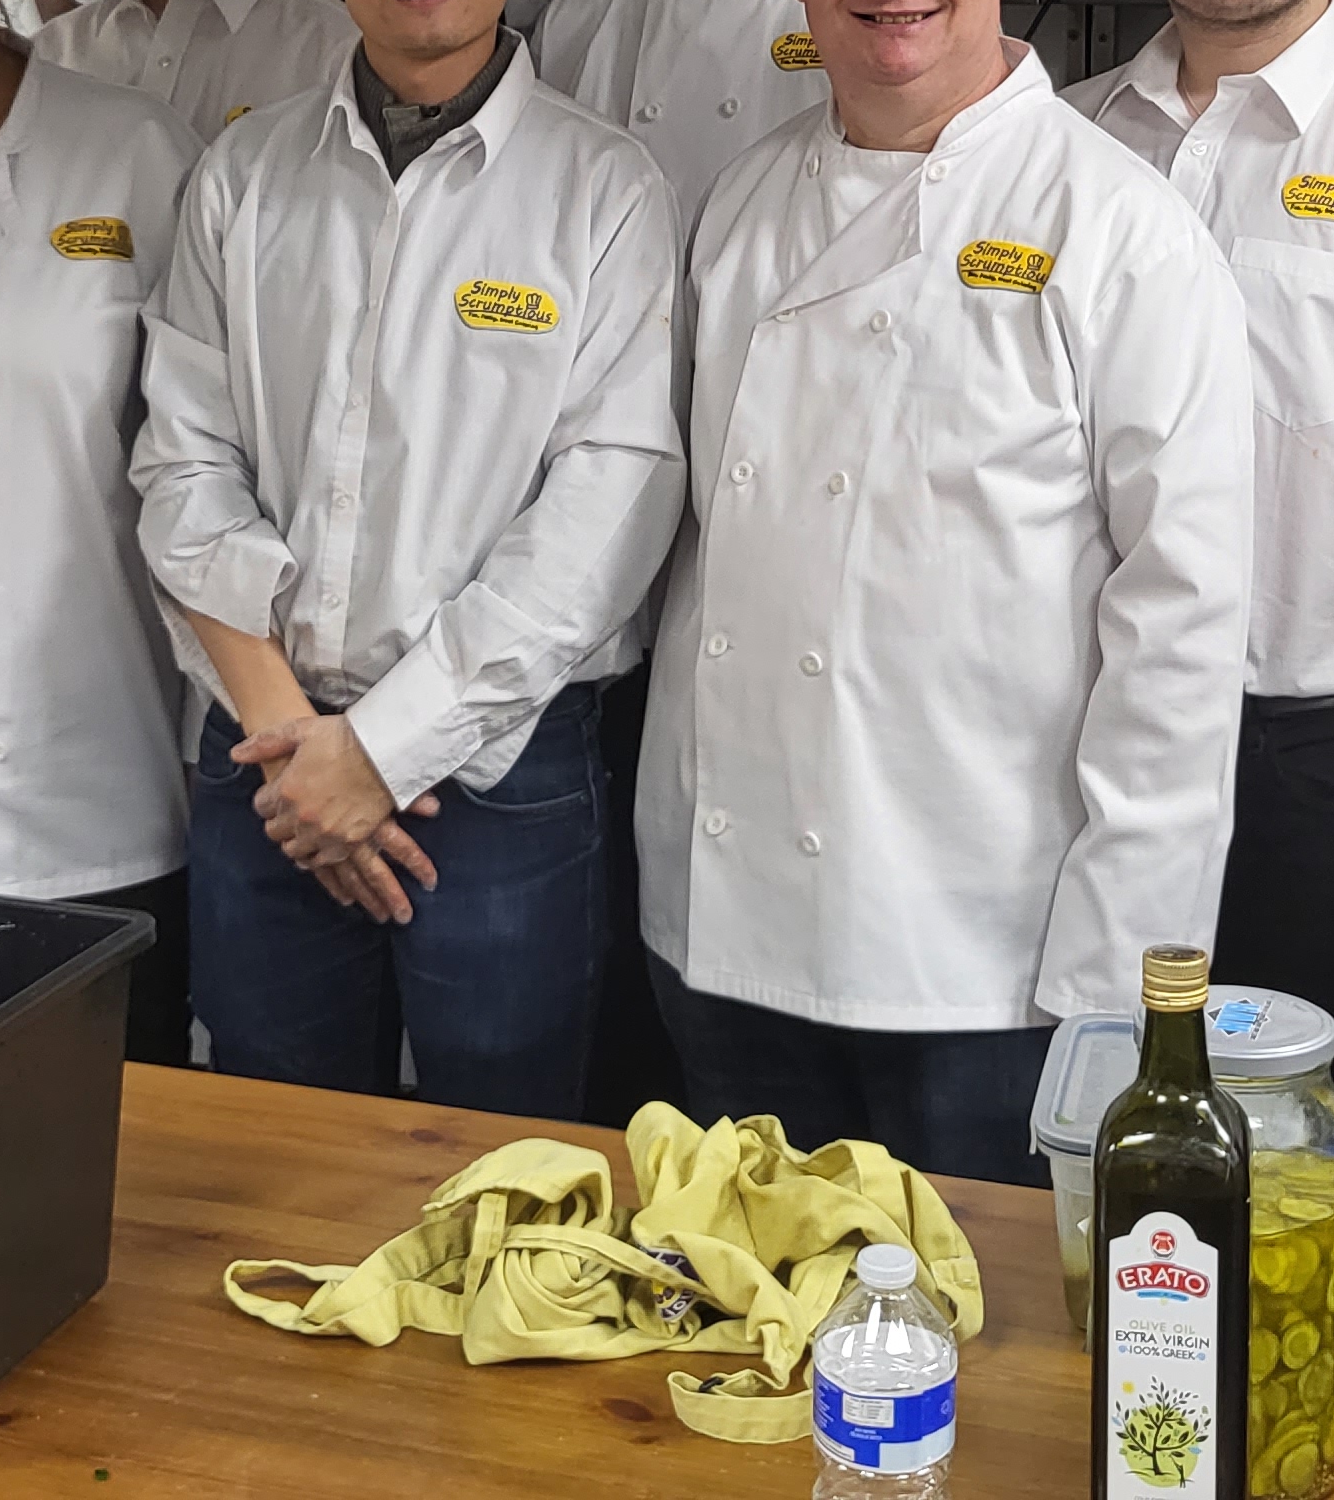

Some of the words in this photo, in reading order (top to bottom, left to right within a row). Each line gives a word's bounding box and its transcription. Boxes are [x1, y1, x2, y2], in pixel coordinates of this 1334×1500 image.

[784, 34, 814, 48] Simp
[775, 45, 819, 58] Scrum
[973, 241, 1023, 263] Simply
[960, 254, 1048, 284] Scrumptiou
[470, 281, 521, 303] Simply
[459, 294, 553, 322] Scrumptious
[1120, 1267, 1205, 1293] ERATO
[1129, 1320, 1166, 1332] OLIVE
[1173, 1324, 1195, 1334] OIL
[1116, 1330, 1157, 1344] EXTRA
[1162, 1334, 1210, 1349] VIRGIN
[1129, 1345, 1160, 1357] 100%
[1162, 1349, 1196, 1360] GREEK
